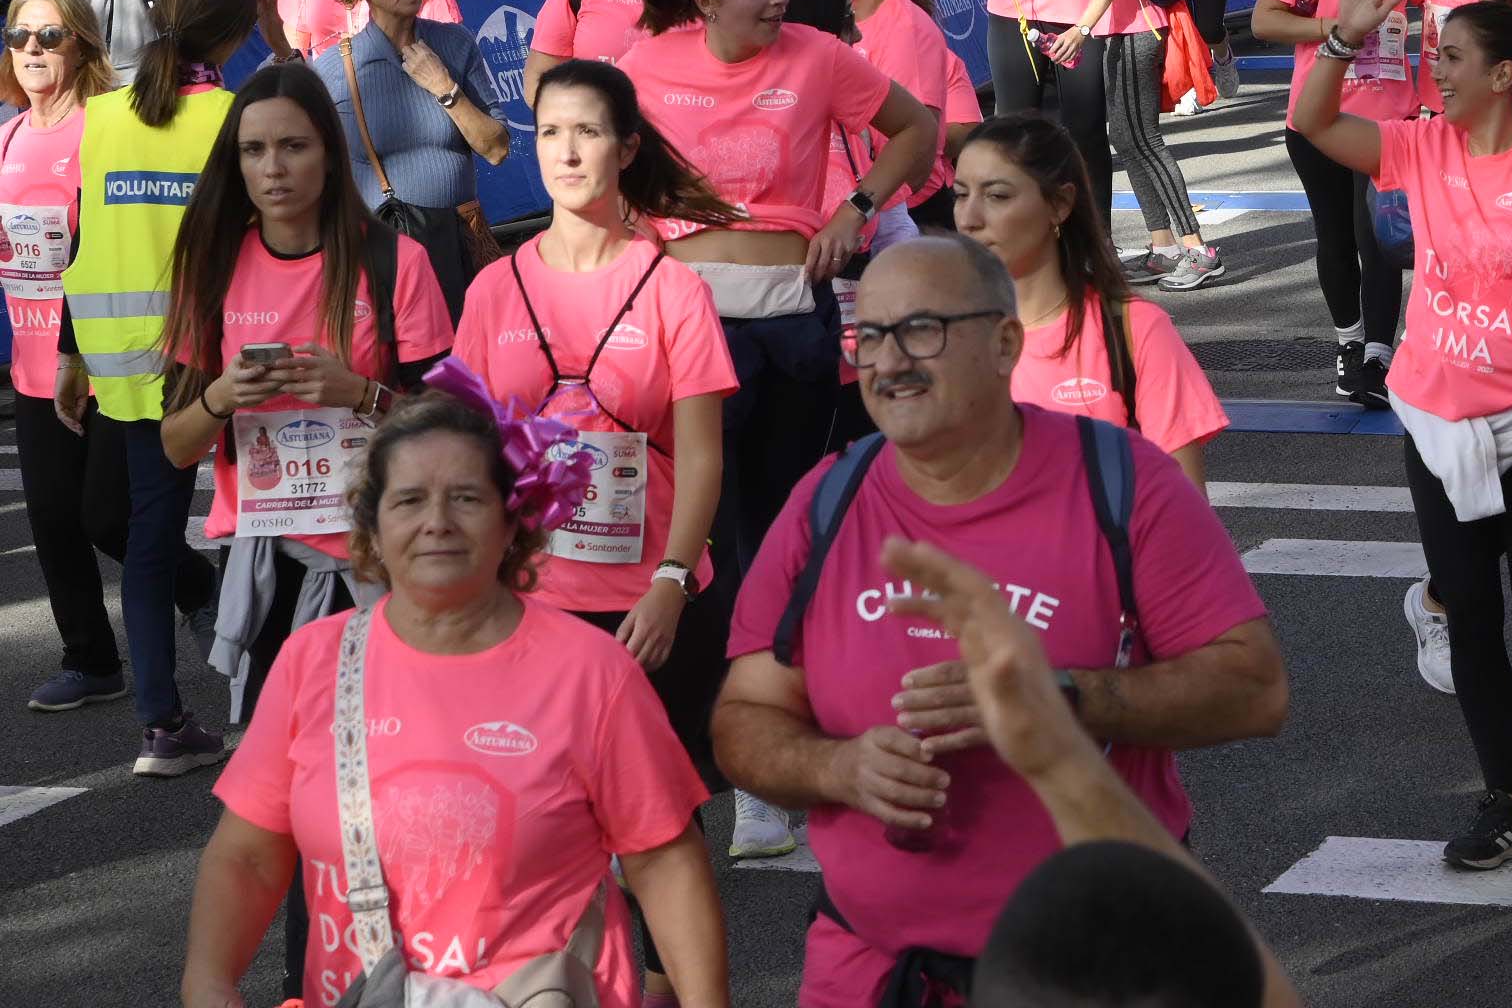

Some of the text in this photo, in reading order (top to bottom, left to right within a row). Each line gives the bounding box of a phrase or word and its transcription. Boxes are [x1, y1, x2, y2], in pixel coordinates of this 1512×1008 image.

[663, 93, 715, 109] OYSHO
[14, 242, 41, 257] 016
[224, 311, 279, 326] OYSHO
[280, 431, 331, 443] ASTURIANA
[285, 458, 331, 478] 016
[290, 482, 327, 494] 31772
[255, 500, 293, 510] CARRERA
[251, 517, 294, 529] OYSHO
[579, 524, 609, 534] MUJER
[587, 542, 632, 553] Santander
[470, 731, 533, 750] ASTURIANA
